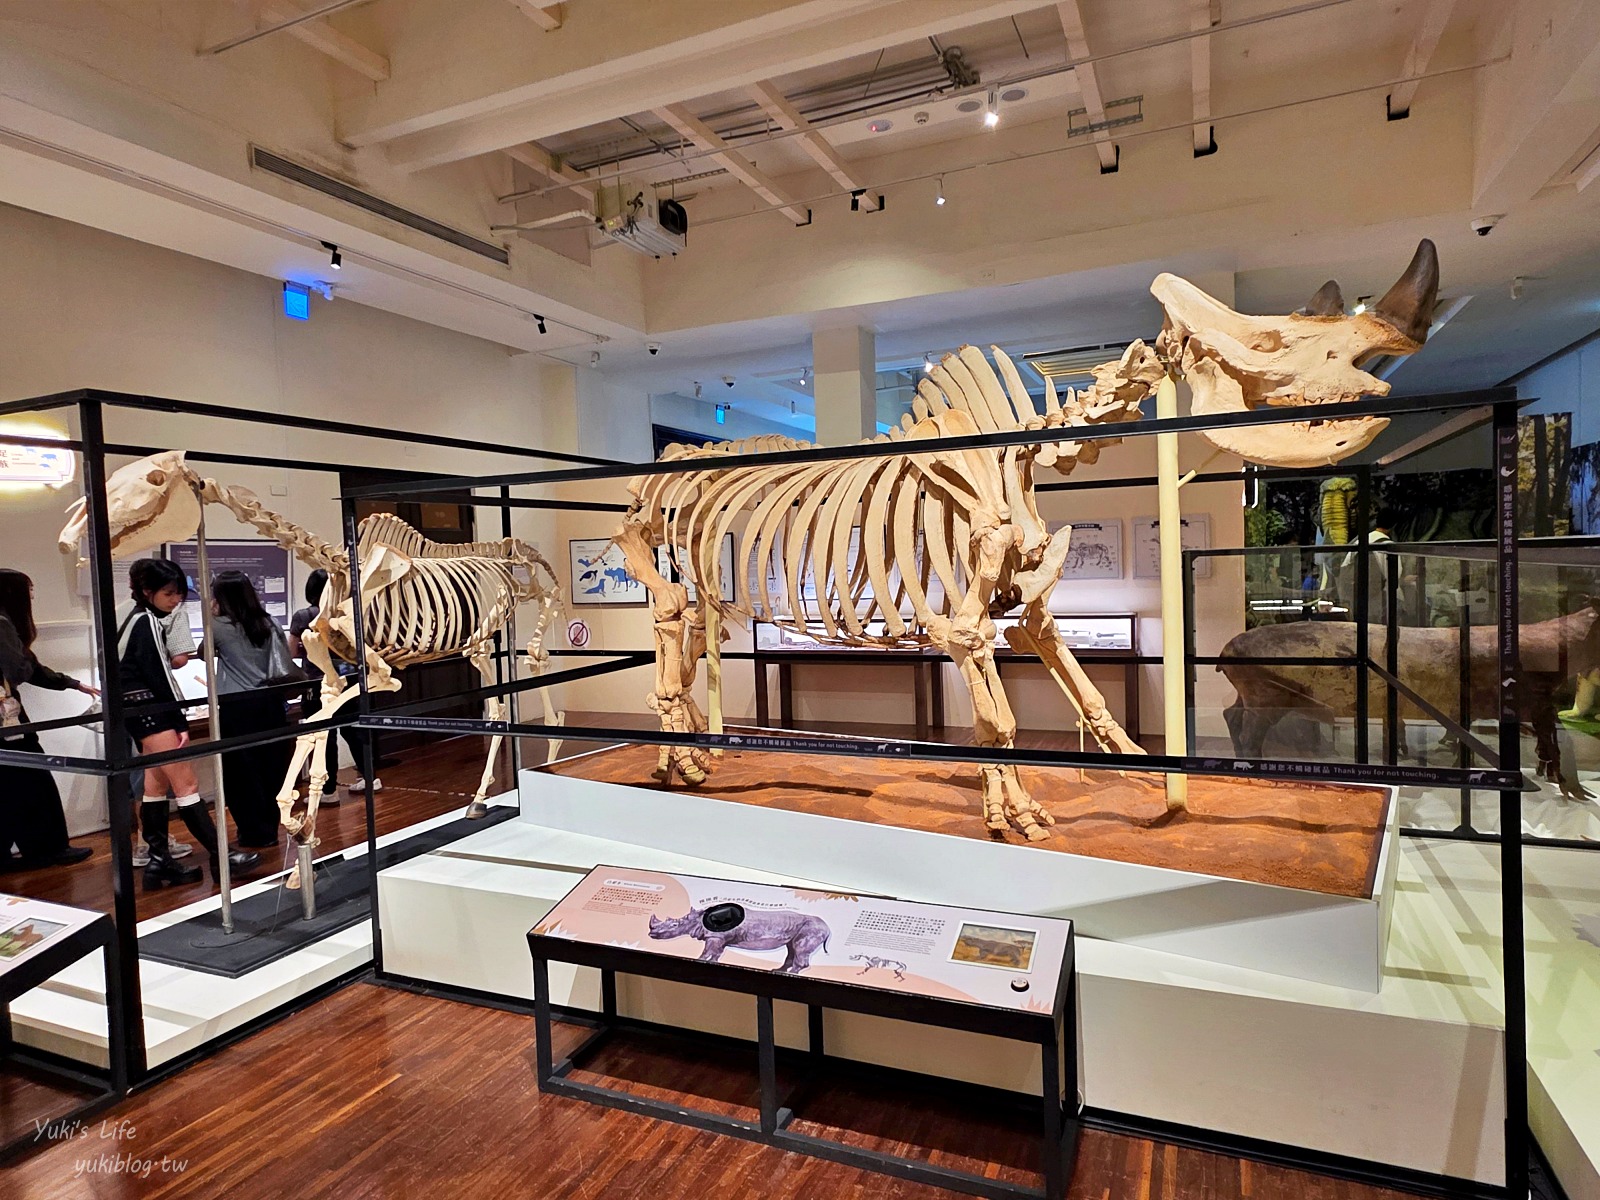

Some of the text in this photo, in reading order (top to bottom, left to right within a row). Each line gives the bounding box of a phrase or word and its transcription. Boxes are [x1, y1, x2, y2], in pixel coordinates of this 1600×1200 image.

[1504, 608, 1512, 619] for
[1505, 620, 1513, 633] you
[1504, 633, 1512, 655] Thank
[1333, 767, 1356, 775] Thank
[1357, 769, 1372, 777] you
[1373, 768, 1385, 776] for
[1401, 770, 1440, 780] touching.
